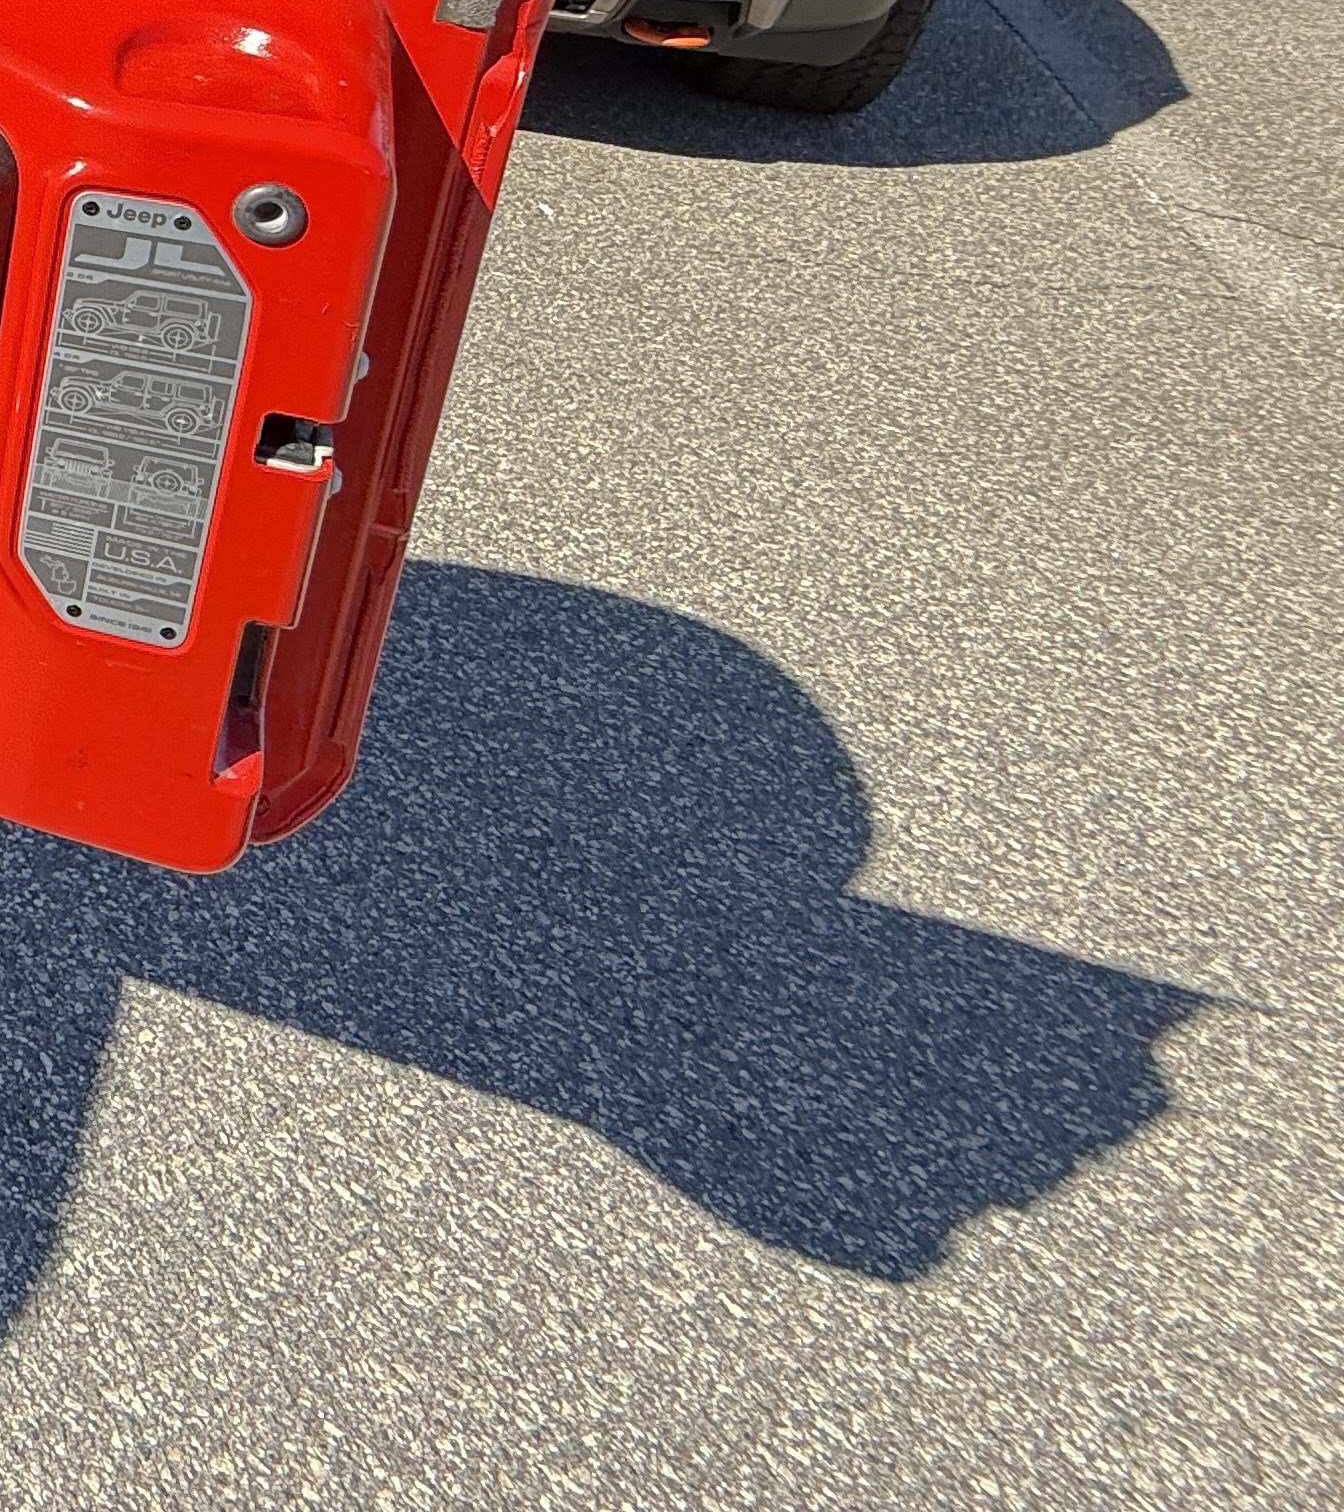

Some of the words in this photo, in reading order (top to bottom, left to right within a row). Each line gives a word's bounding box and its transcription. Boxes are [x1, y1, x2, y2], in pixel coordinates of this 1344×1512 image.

[106, 203, 167, 228] Jeep
[74, 237, 225, 276] JL
[104, 542, 183, 574] U.S.A.
